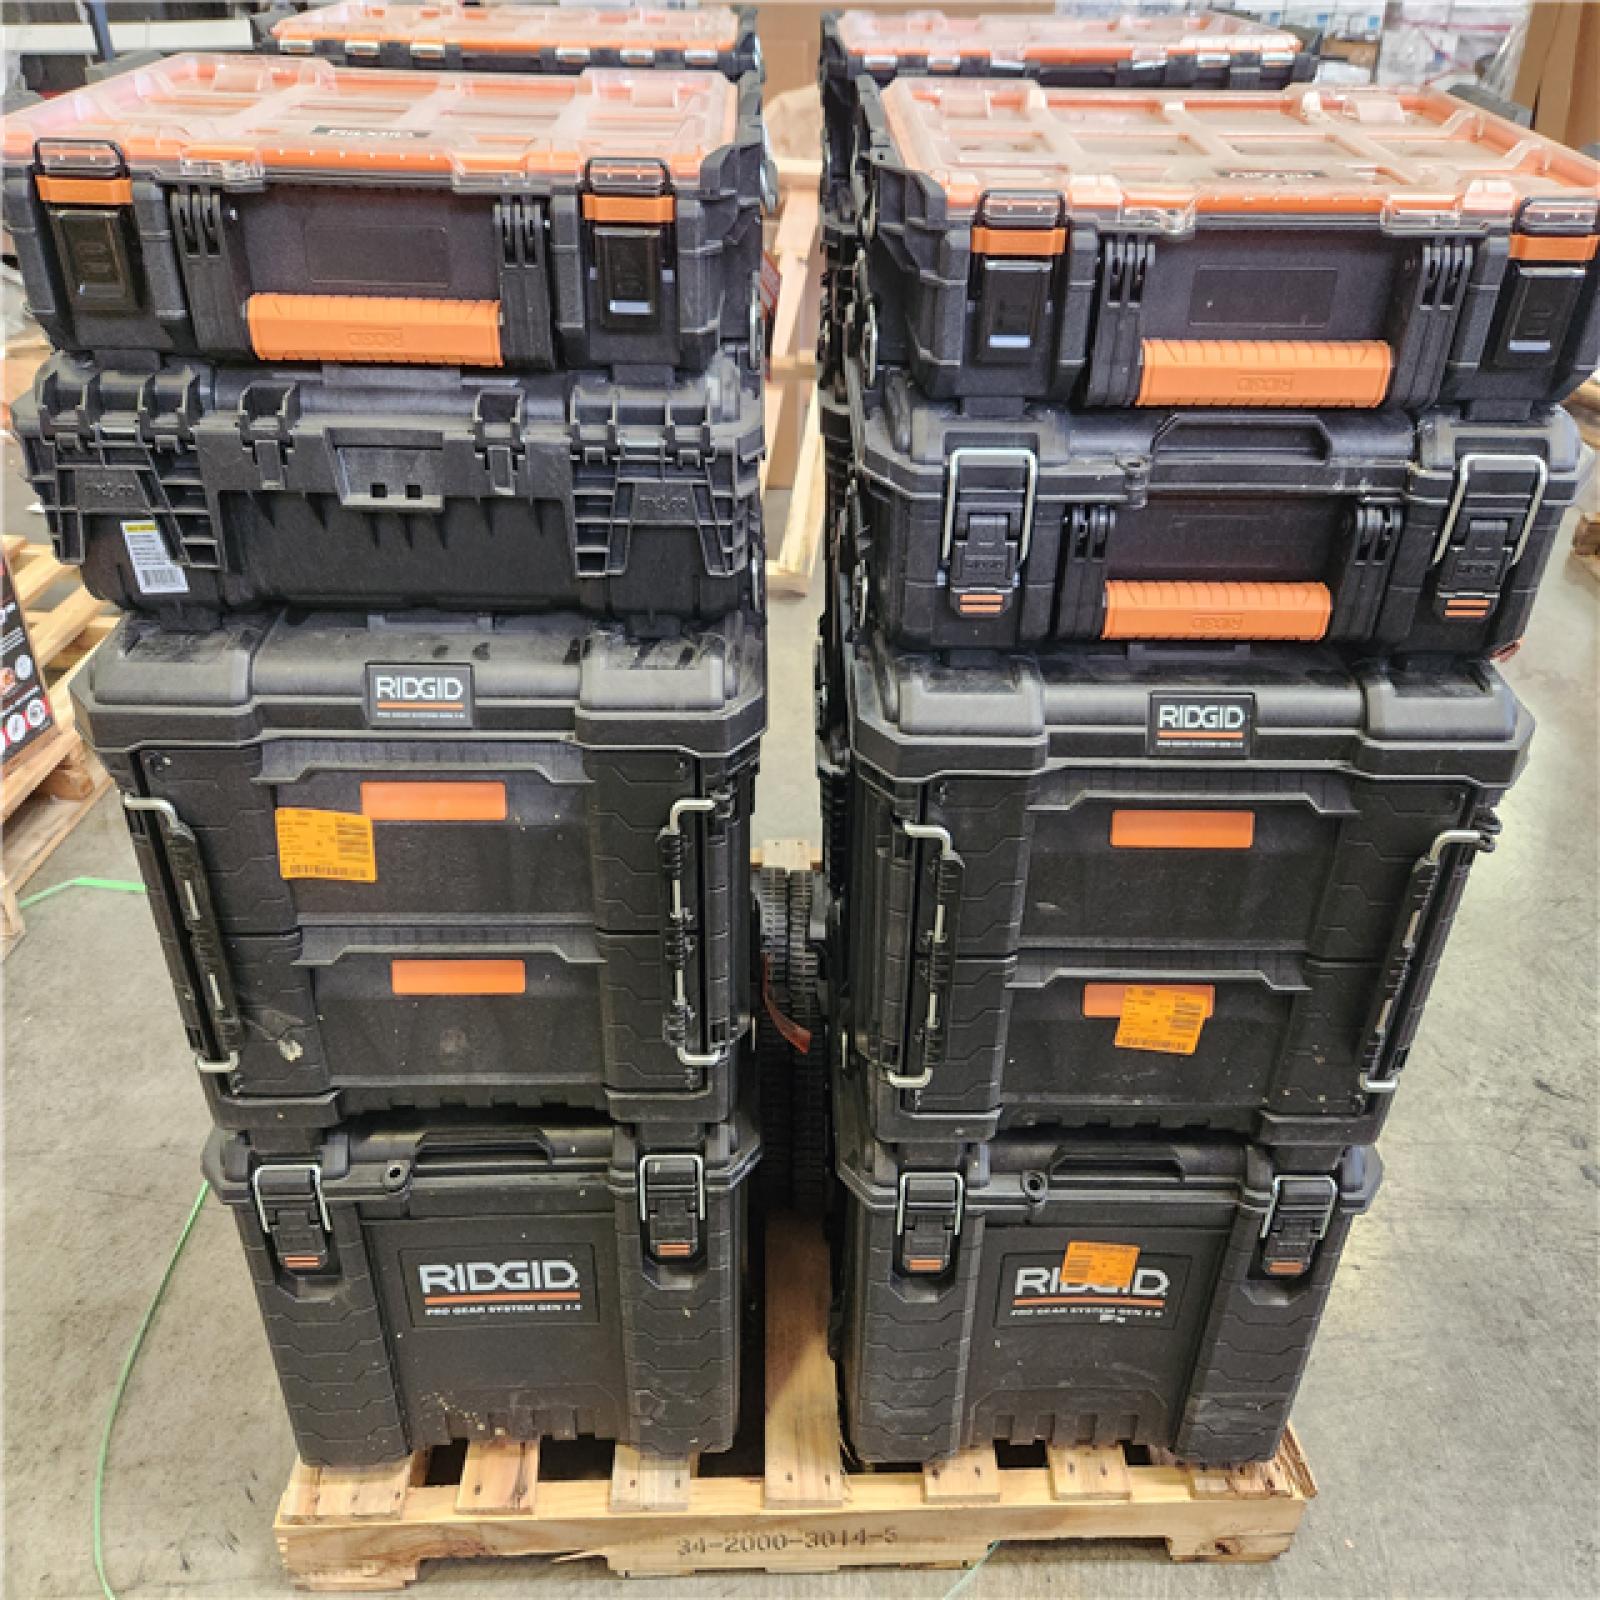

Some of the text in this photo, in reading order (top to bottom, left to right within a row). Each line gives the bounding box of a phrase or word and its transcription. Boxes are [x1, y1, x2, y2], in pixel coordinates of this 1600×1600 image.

[376, 676, 464, 699] RIDGID
[1158, 704, 1245, 729] RIDGID
[419, 1260, 580, 1293] RIDGID
[679, 1525, 898, 1556] 34-2000-3014-5
